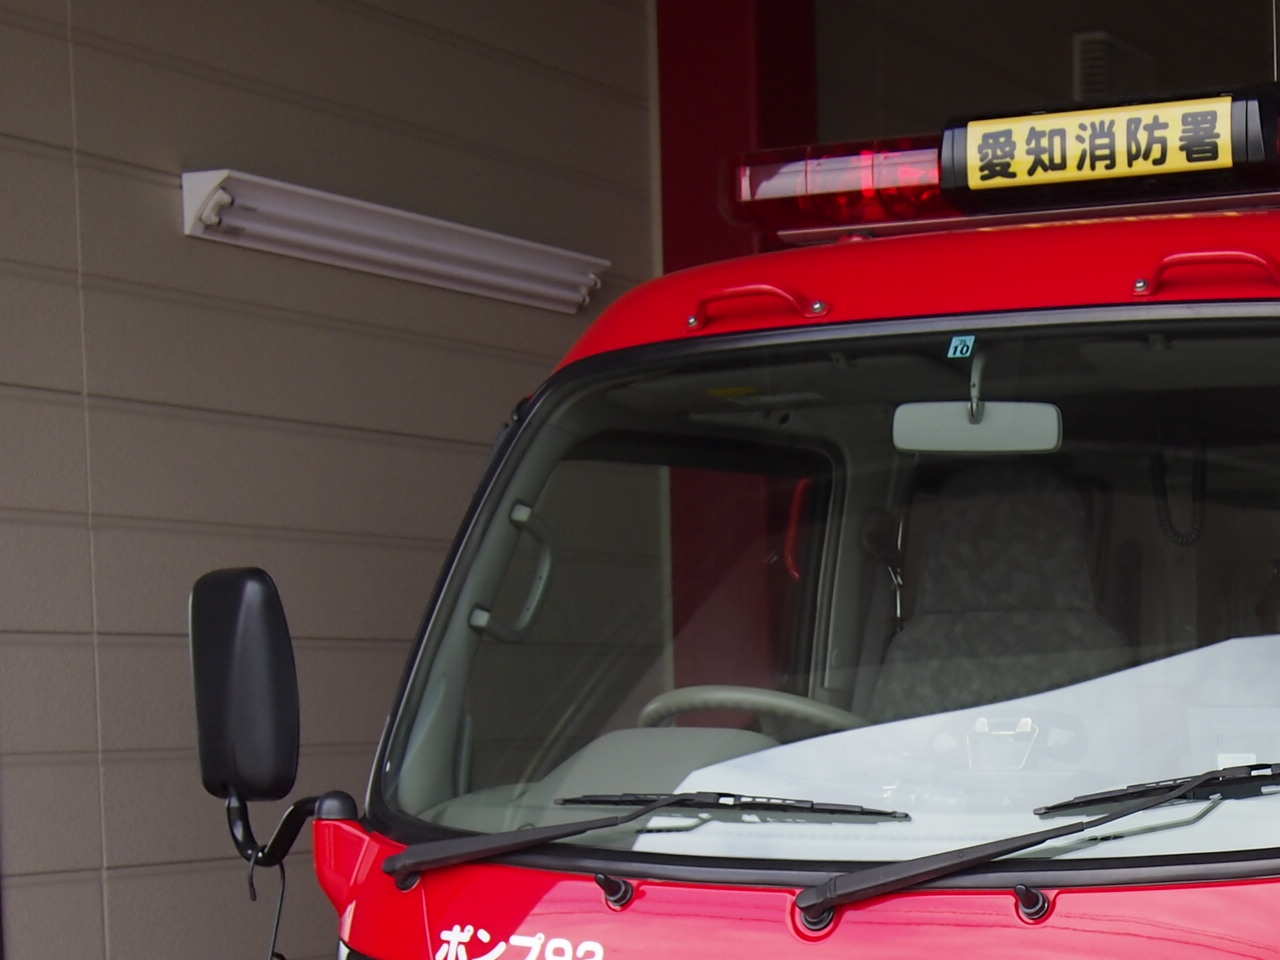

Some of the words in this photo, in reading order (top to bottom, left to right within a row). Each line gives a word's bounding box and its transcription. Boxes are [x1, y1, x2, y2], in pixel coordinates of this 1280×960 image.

[977, 110, 1221, 181] 愛知消防署
[953, 344, 970, 356] 10
